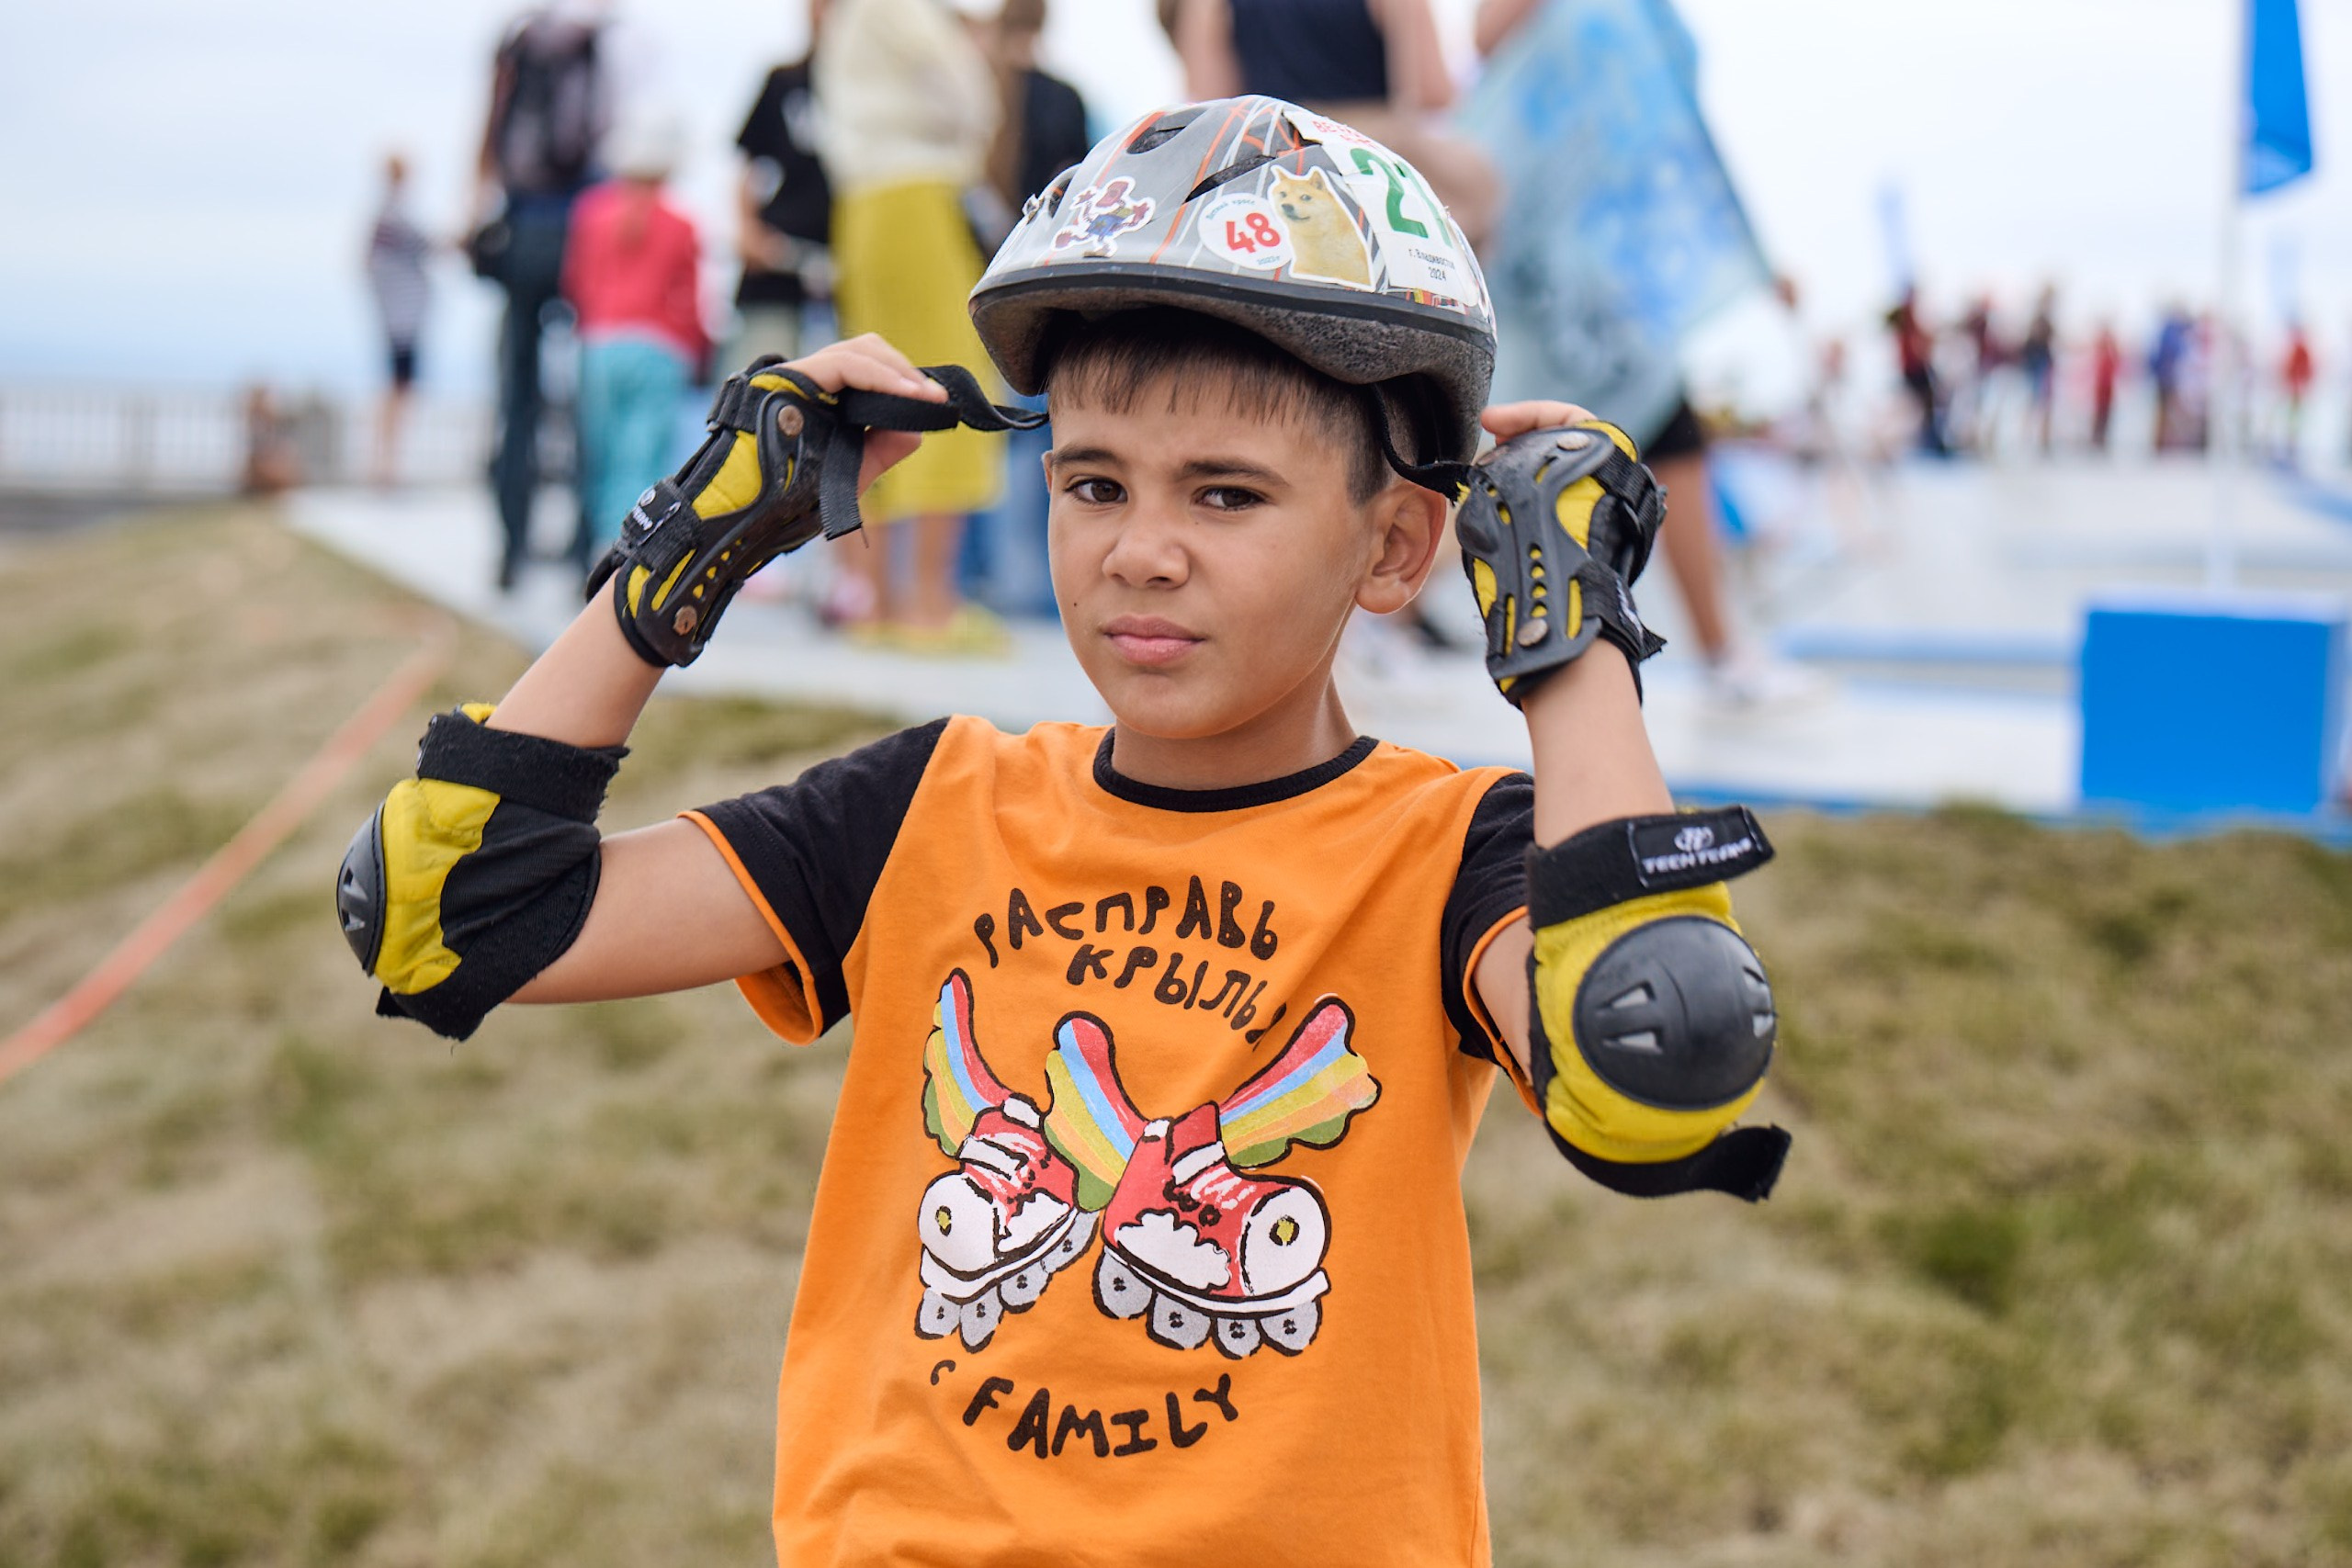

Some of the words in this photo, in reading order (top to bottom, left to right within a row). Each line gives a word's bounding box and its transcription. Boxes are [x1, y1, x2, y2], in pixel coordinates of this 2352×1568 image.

[1226, 212, 1281, 254] 48
[974, 875, 1278, 969] РАСПРАВЬ
[962, 1373, 1238, 1459] FAMILY
